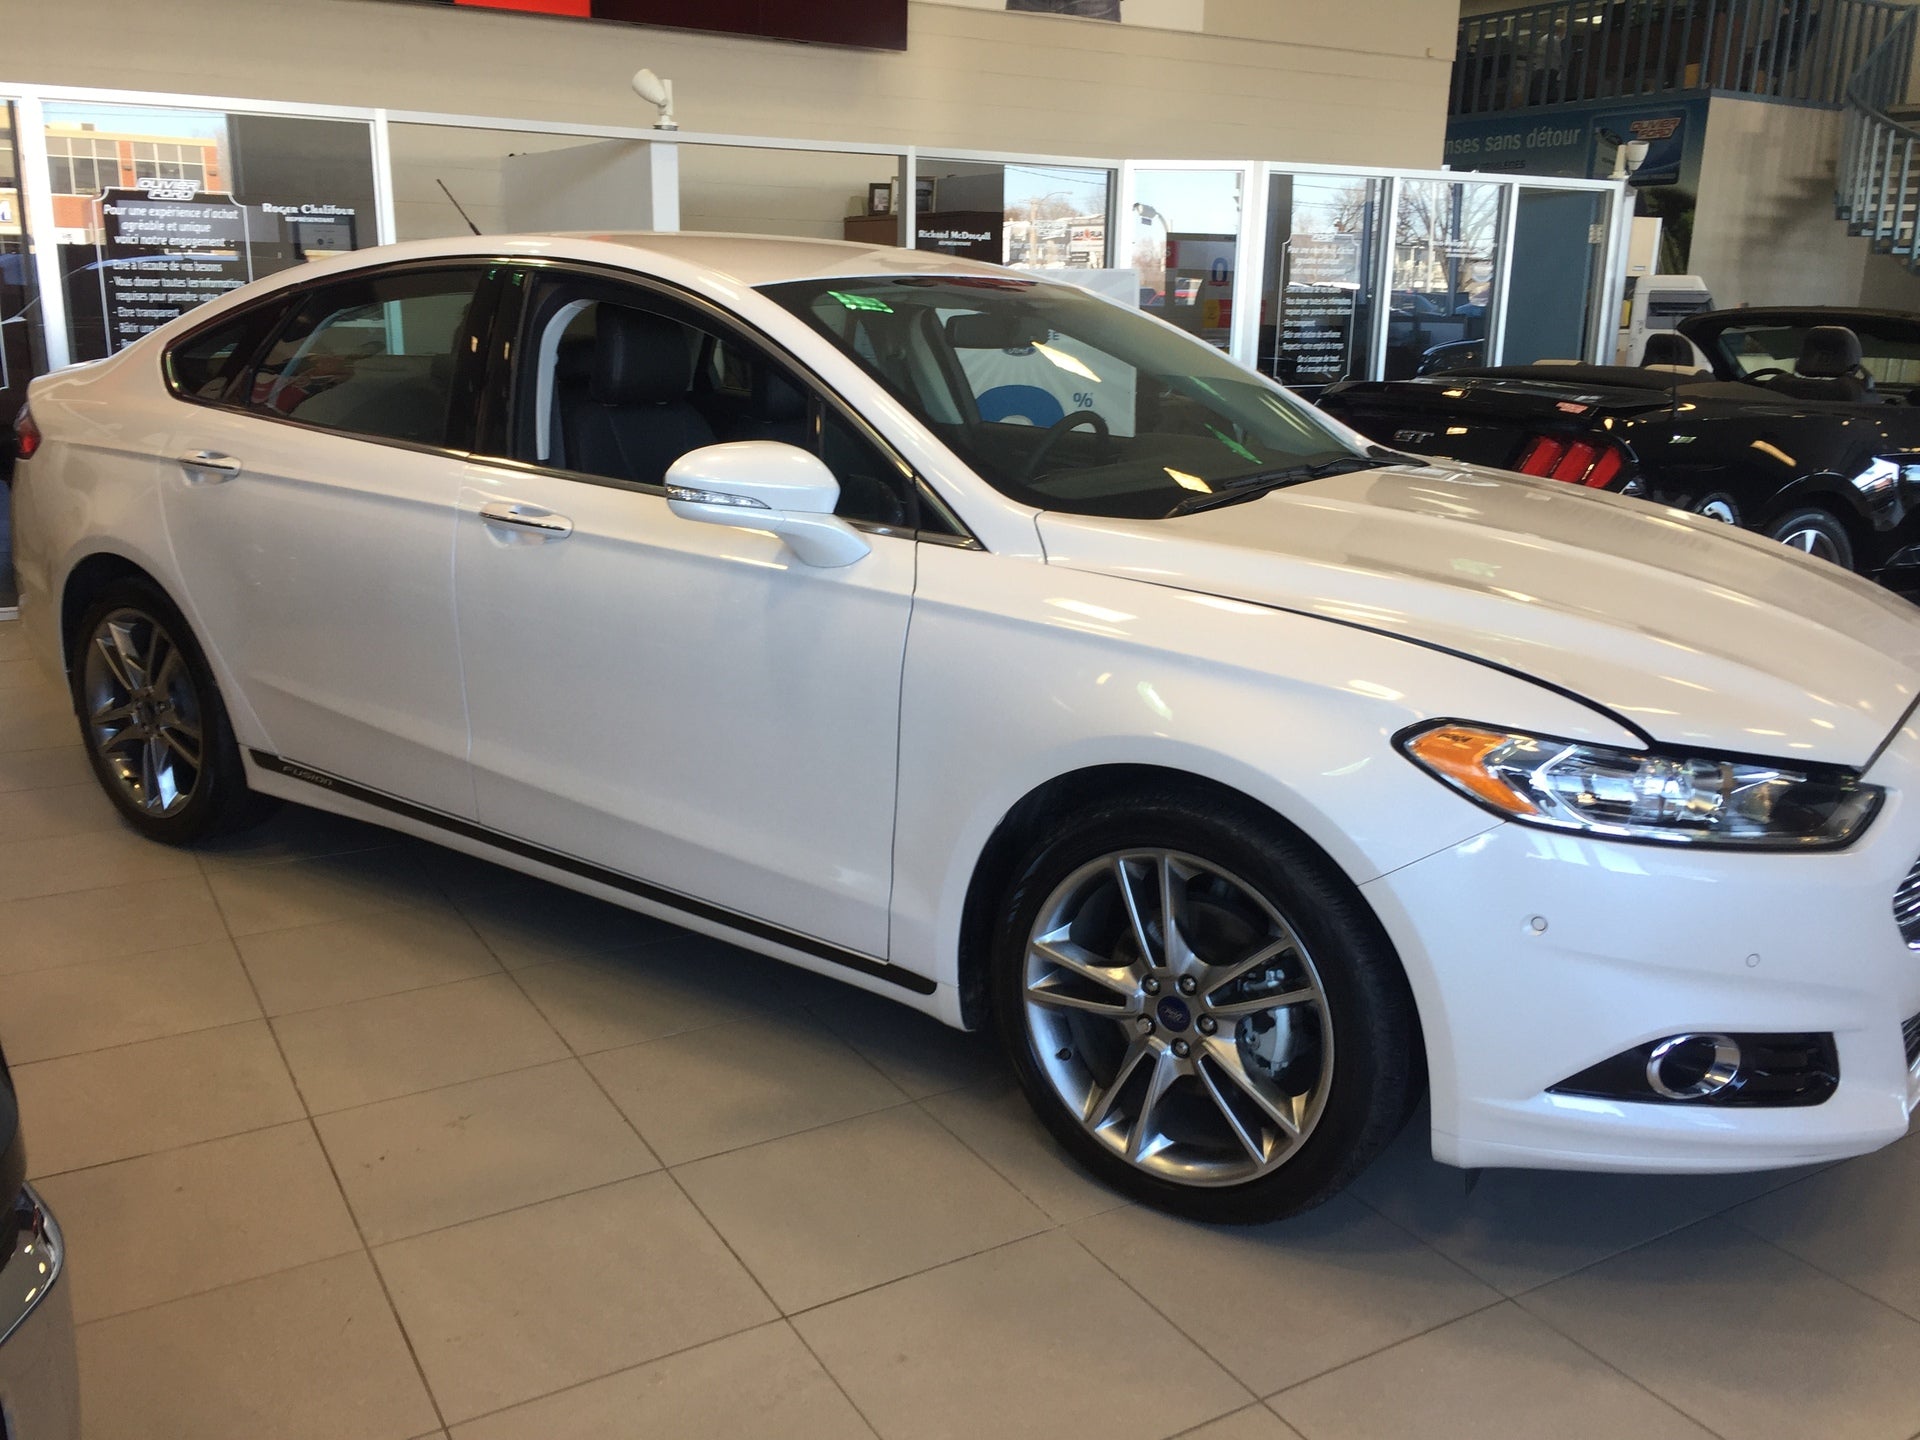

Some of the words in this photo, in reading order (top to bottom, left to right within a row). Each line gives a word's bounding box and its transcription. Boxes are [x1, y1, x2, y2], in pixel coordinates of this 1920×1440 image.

[1485, 134, 1521, 151] sans
[1526, 126, 1581, 149] détour
[140, 179, 200, 191] OLIVIER
[151, 189, 193, 199] FORD
[103, 204, 127, 215] Pour
[128, 207, 147, 216] une
[148, 206, 201, 219] expérience
[202, 207, 239, 219] d'achat
[121, 219, 165, 233] agréable
[166, 221, 178, 231] et
[178, 221, 212, 234] unique
[114, 234, 139, 245] voici
[140, 235, 168, 245] notre
[169, 236, 226, 248] engagement
[918, 230, 949, 239] Richard
[950, 231, 991, 241] McDougall
[1392, 429, 1435, 444] GT
